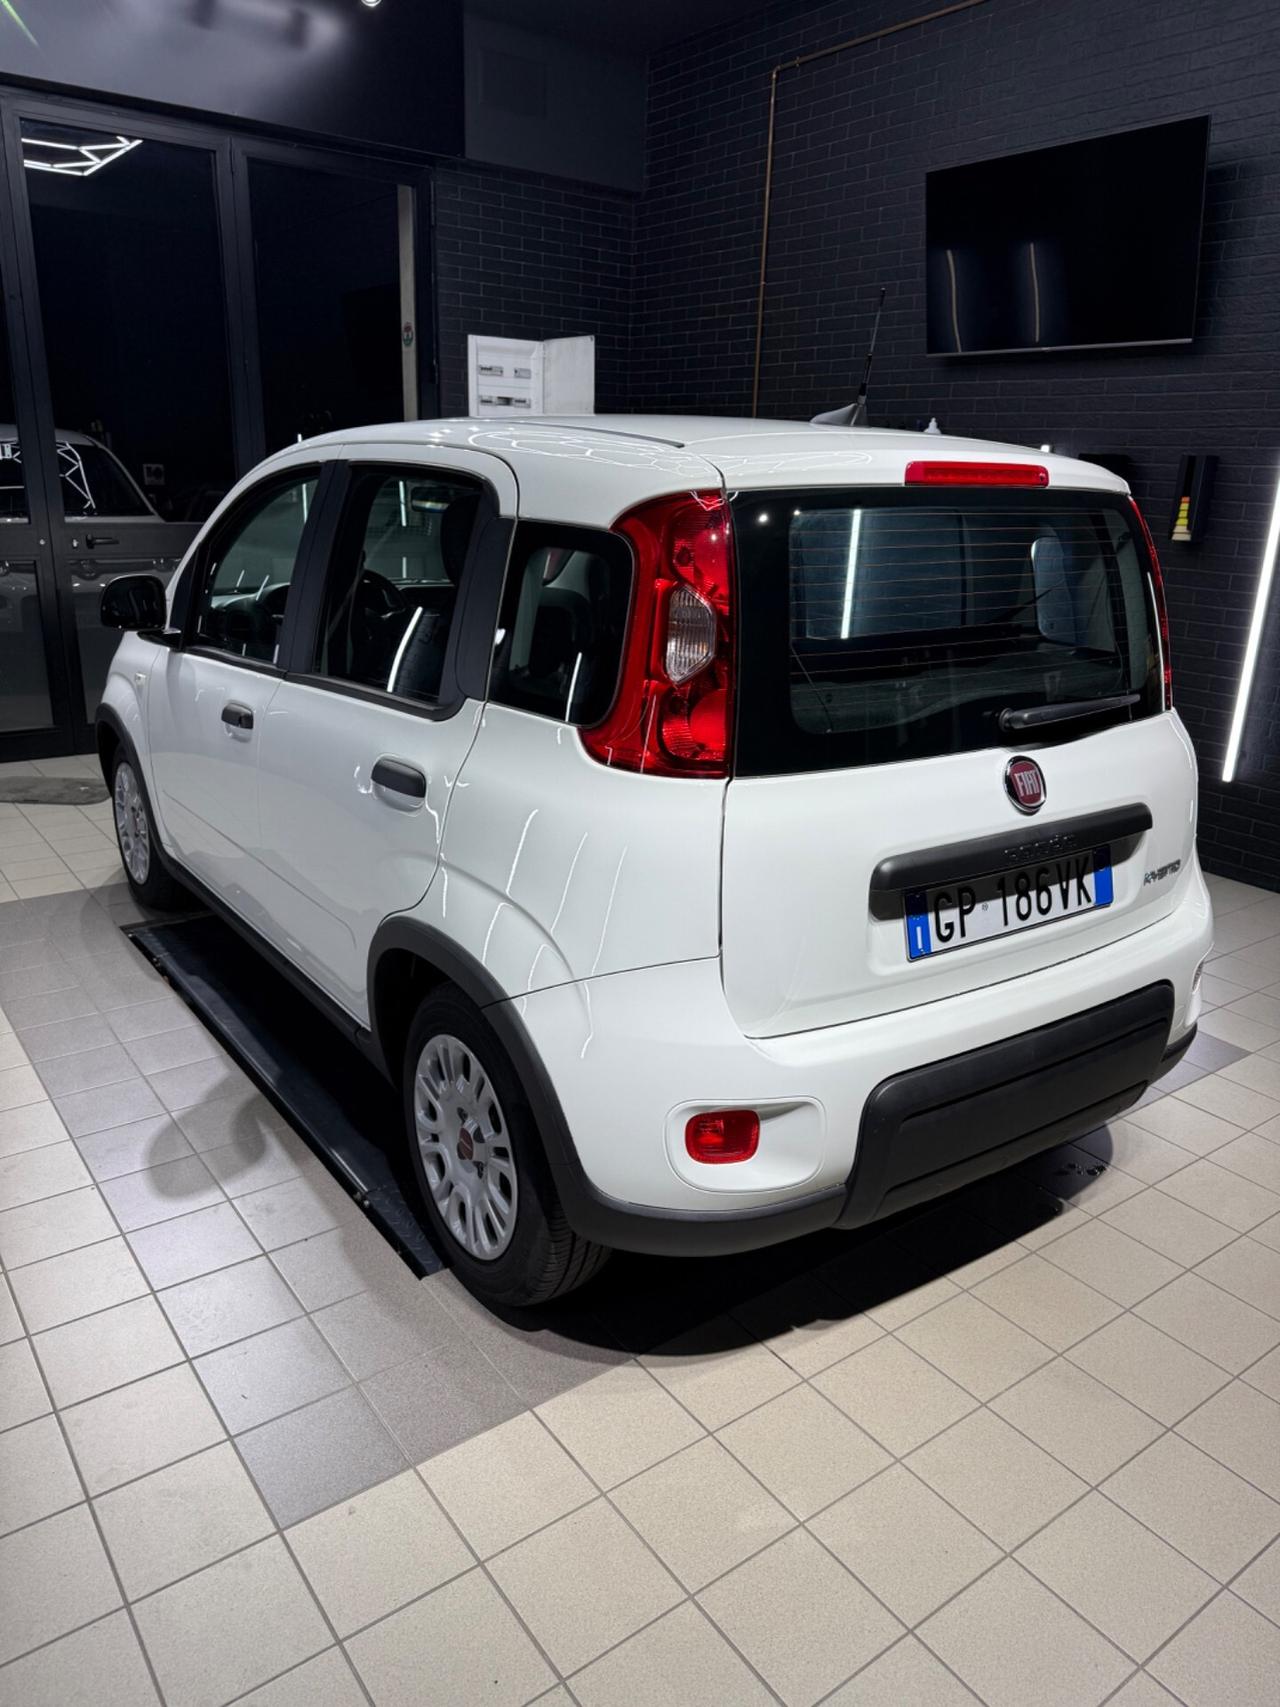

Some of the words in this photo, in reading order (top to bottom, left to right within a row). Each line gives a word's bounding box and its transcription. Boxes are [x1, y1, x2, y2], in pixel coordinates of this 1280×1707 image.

[1013, 769, 1040, 797] FIAT
[934, 886, 976, 943] GP
[997, 856, 1092, 927] 186VK
